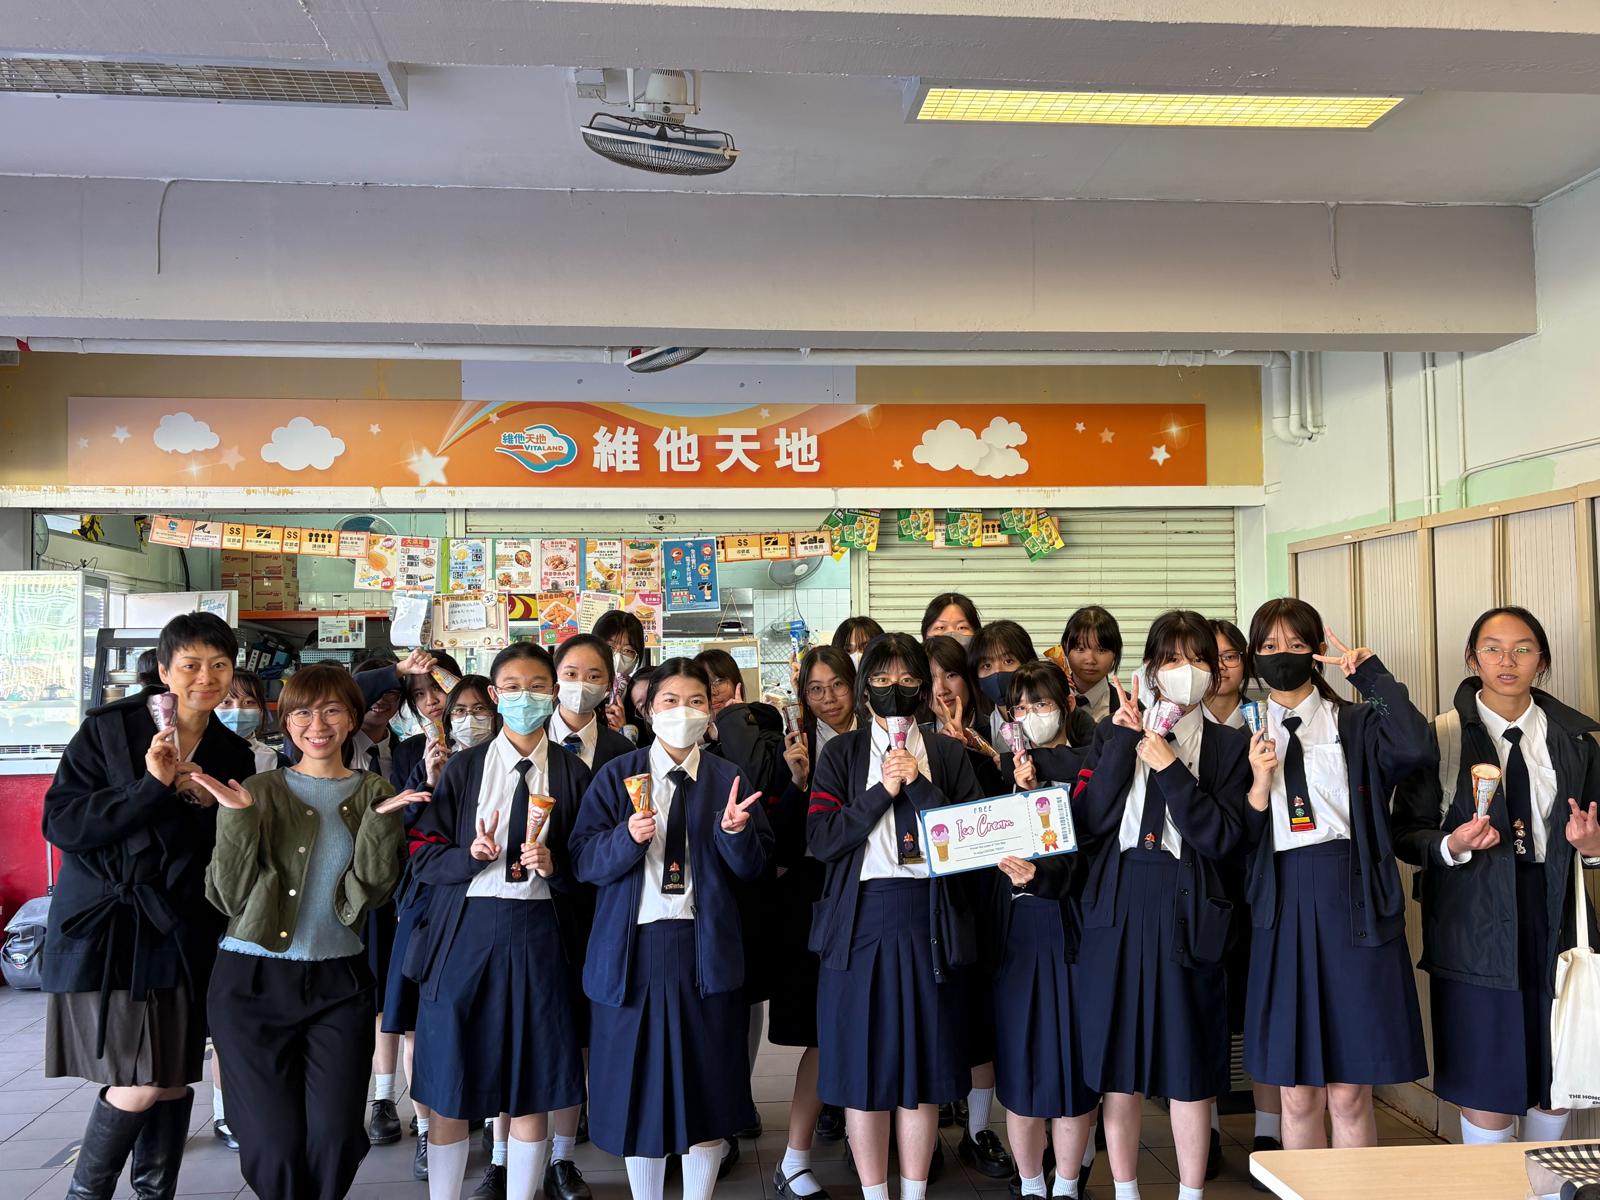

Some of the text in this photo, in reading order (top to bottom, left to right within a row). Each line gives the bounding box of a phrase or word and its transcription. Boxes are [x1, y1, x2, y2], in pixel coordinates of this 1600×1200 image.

[502, 433, 547, 445] 維他天地
[592, 425, 821, 473] 維他天地
[973, 805, 992, 814] FREE
[955, 813, 1015, 842] Ice Cream
